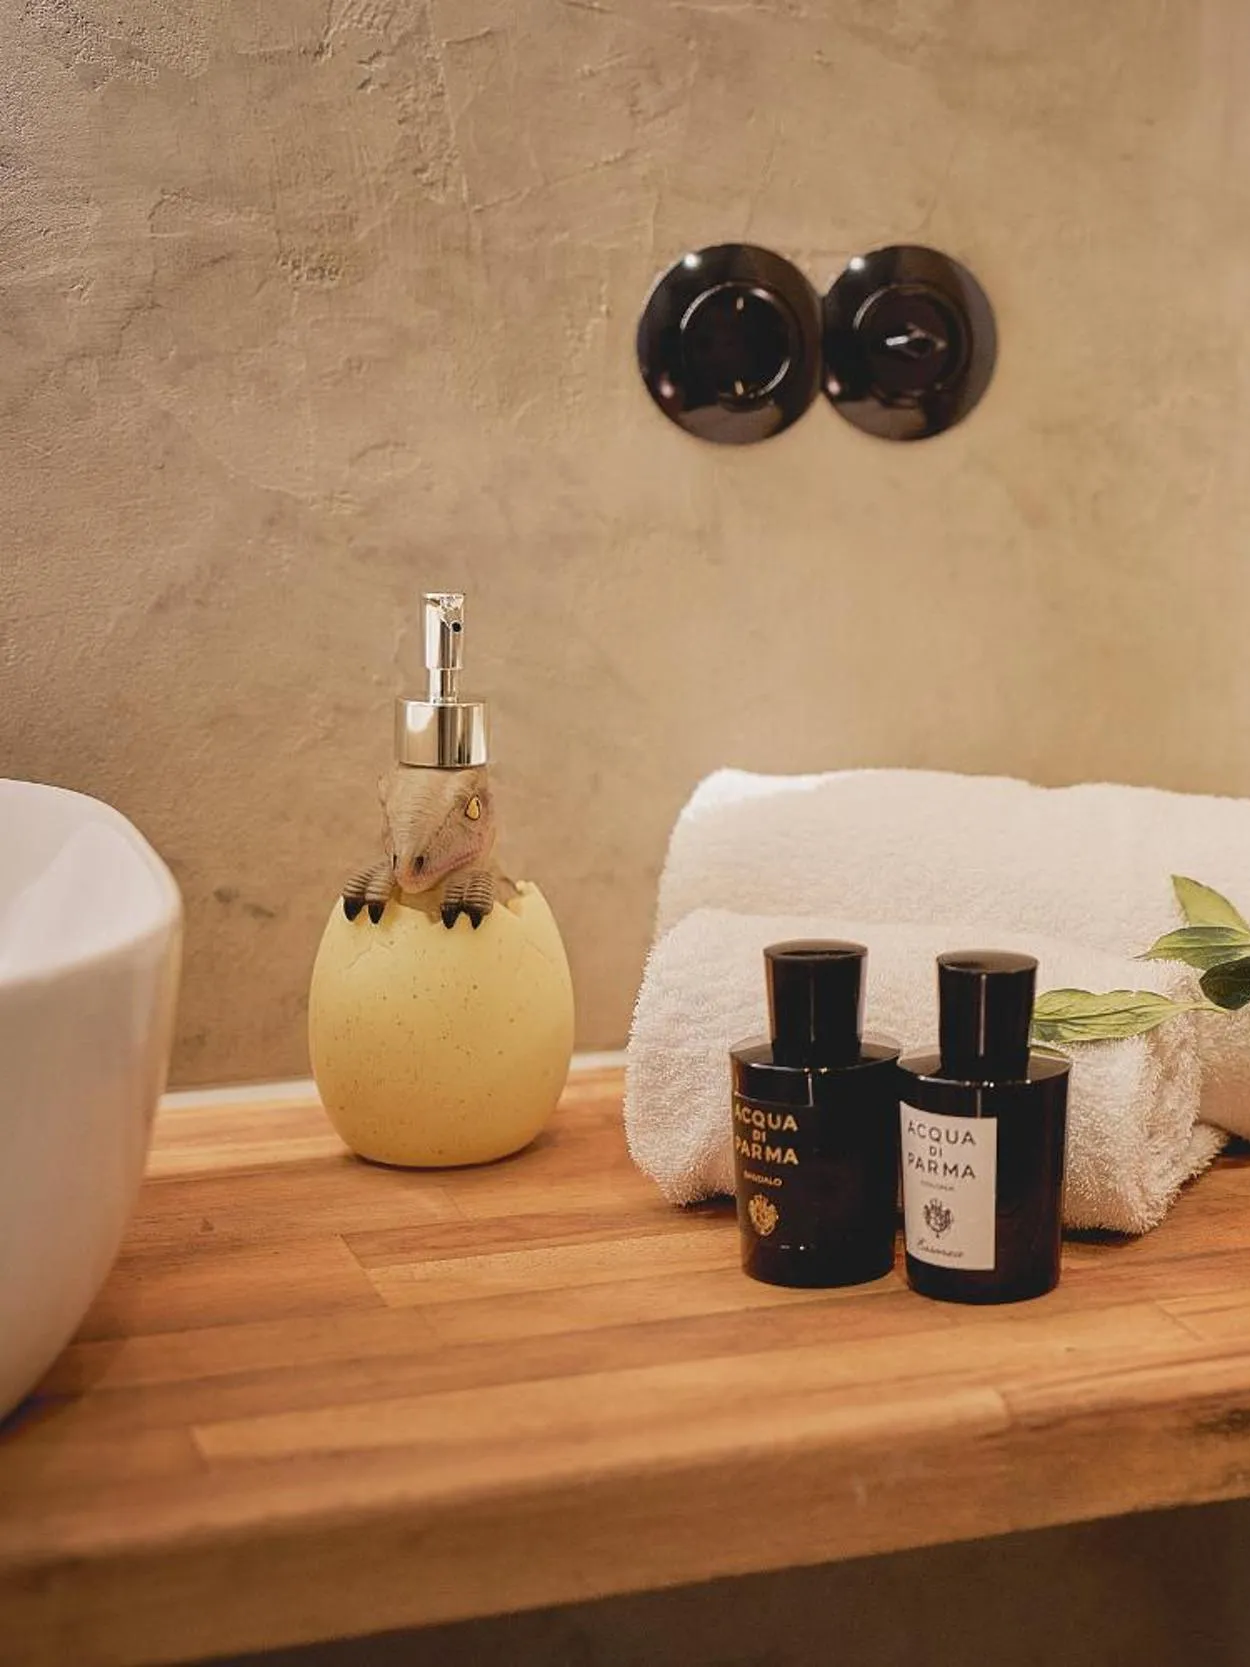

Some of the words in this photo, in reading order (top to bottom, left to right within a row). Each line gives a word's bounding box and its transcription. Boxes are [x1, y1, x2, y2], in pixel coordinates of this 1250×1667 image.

[735, 1103, 799, 1132] ACQUA
[752, 1129, 767, 1143] DI
[908, 1120, 976, 1146] ACQUA
[735, 1135, 799, 1165] PARMA
[929, 1145, 943, 1158] DI
[908, 1152, 976, 1180] PARMA
